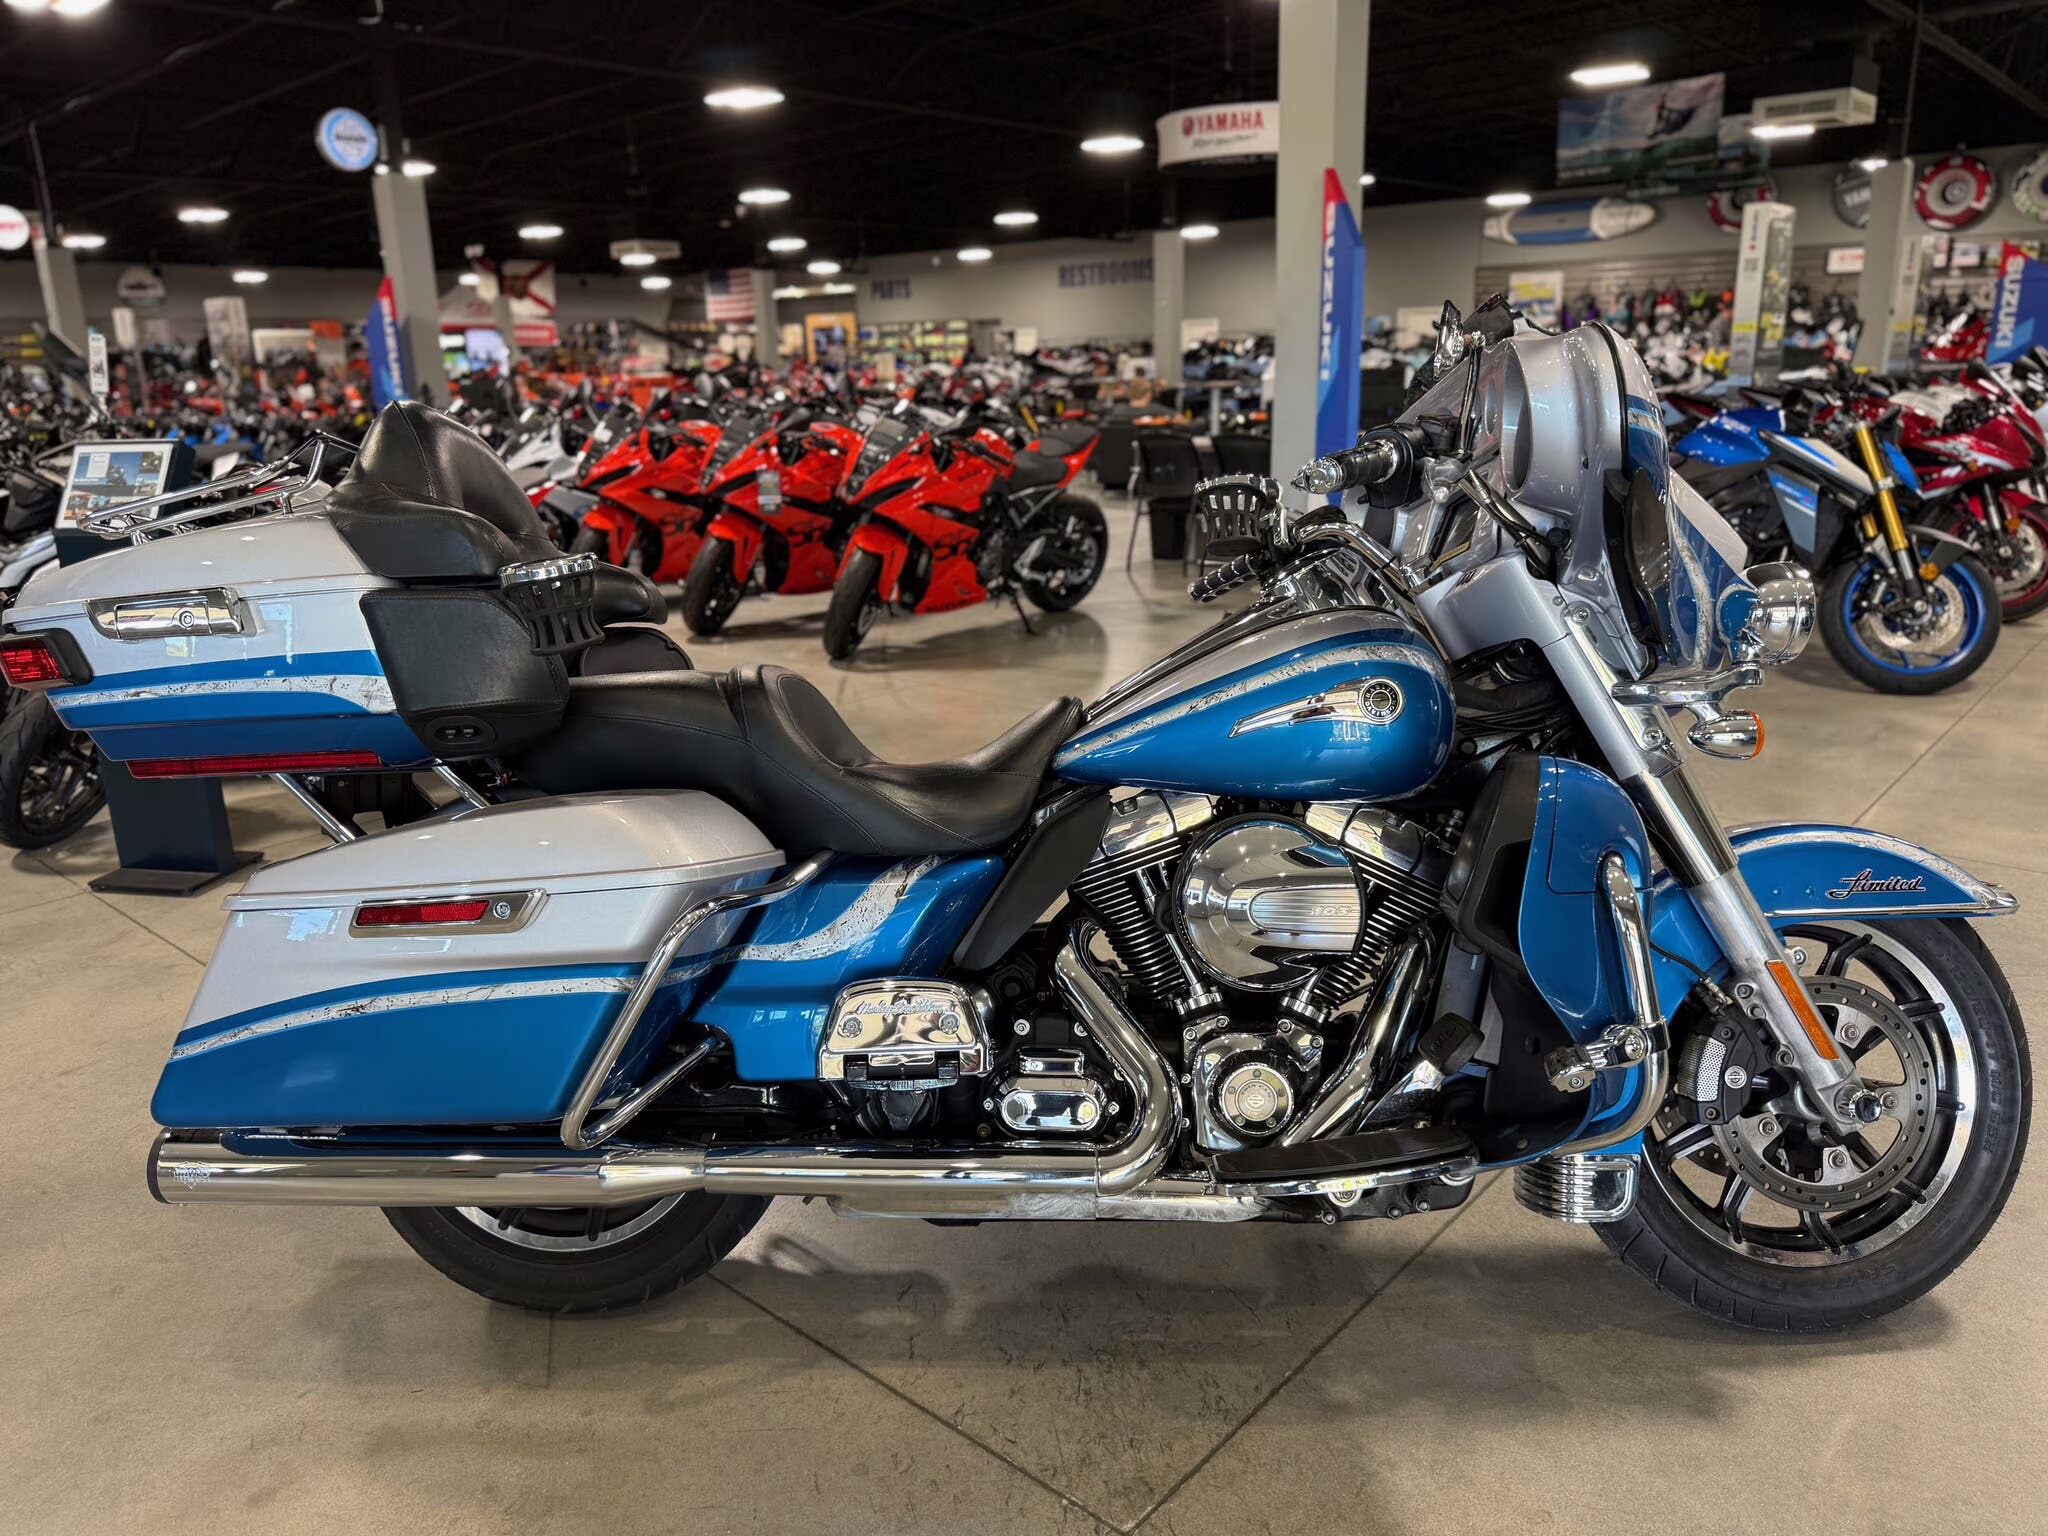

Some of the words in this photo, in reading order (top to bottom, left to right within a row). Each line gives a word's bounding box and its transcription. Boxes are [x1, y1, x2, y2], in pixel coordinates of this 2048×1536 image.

[1196, 111, 1264, 134] YAMAHA
[1058, 259, 1154, 289] RESTROOMS
[870, 279, 912, 300] PARTS
[1320, 200, 1336, 380] SUZUKI
[1995, 254, 2025, 348] SUZUKI
[1825, 868, 1926, 899] Limited
